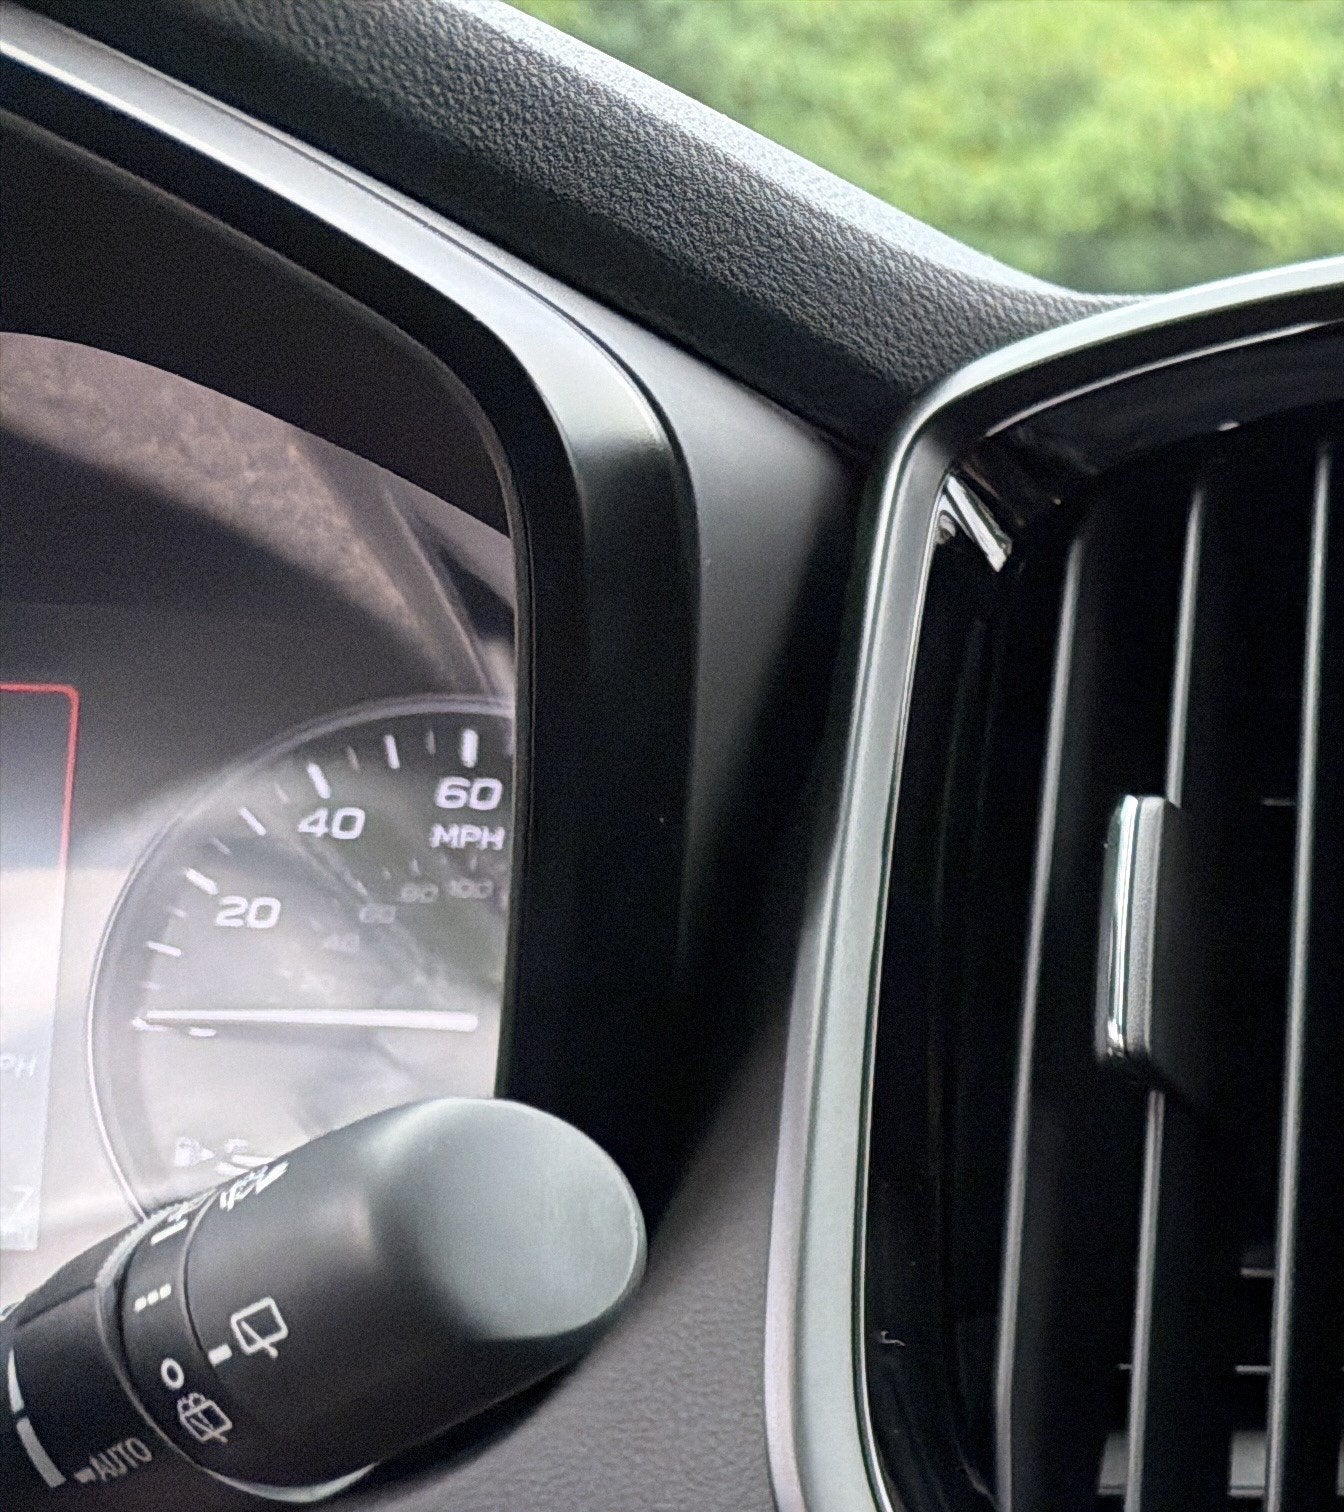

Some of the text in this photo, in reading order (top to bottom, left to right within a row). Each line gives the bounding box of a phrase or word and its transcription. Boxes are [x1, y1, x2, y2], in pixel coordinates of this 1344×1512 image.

[434, 775, 504, 812] 60
[297, 806, 366, 840] 40
[429, 823, 506, 850] MPH
[215, 896, 282, 930] 20
[89, 1437, 153, 1482] AUTO
